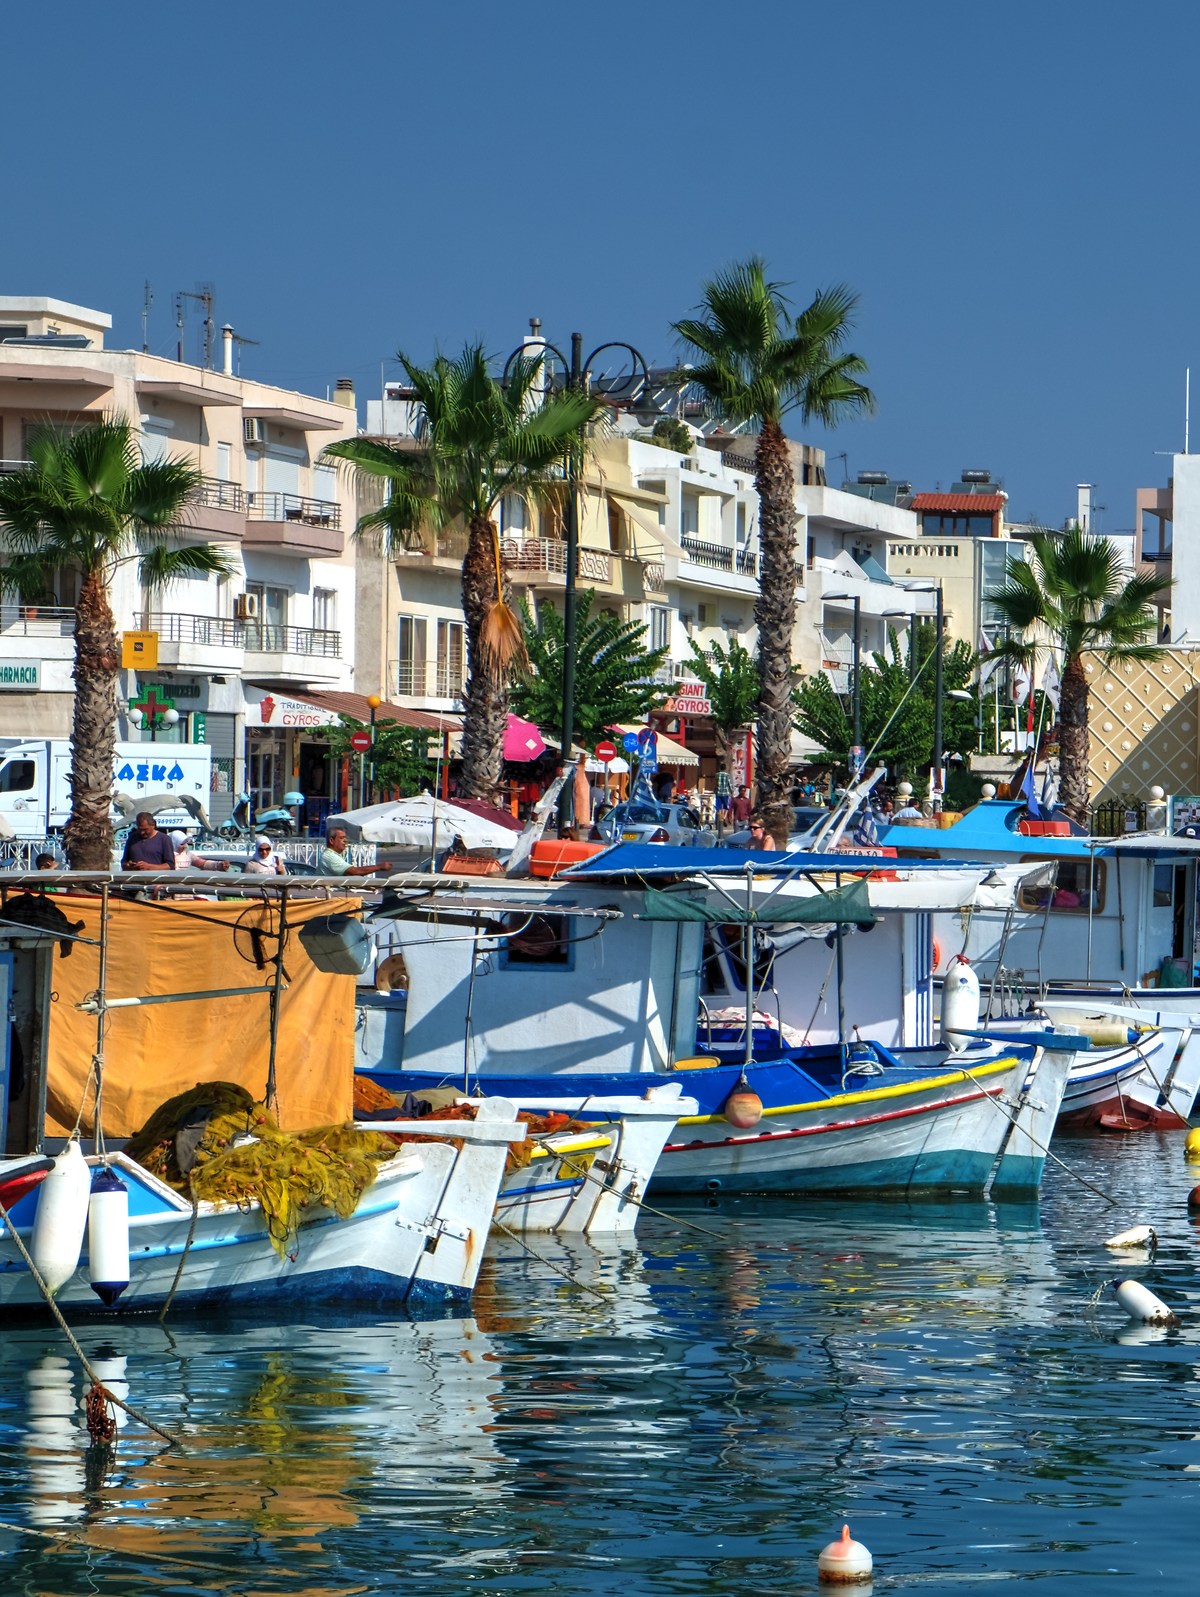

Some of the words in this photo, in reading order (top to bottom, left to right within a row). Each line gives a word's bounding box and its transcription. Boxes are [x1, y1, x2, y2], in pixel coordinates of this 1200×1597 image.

[680, 683, 705, 697] GIANT
[677, 699, 710, 713] GYROS
[282, 714, 320, 726] GYROS
[197, 723, 206, 744] PHA
[113, 763, 184, 782] ΑΣΚΑ
[392, 816, 435, 825] Corona
